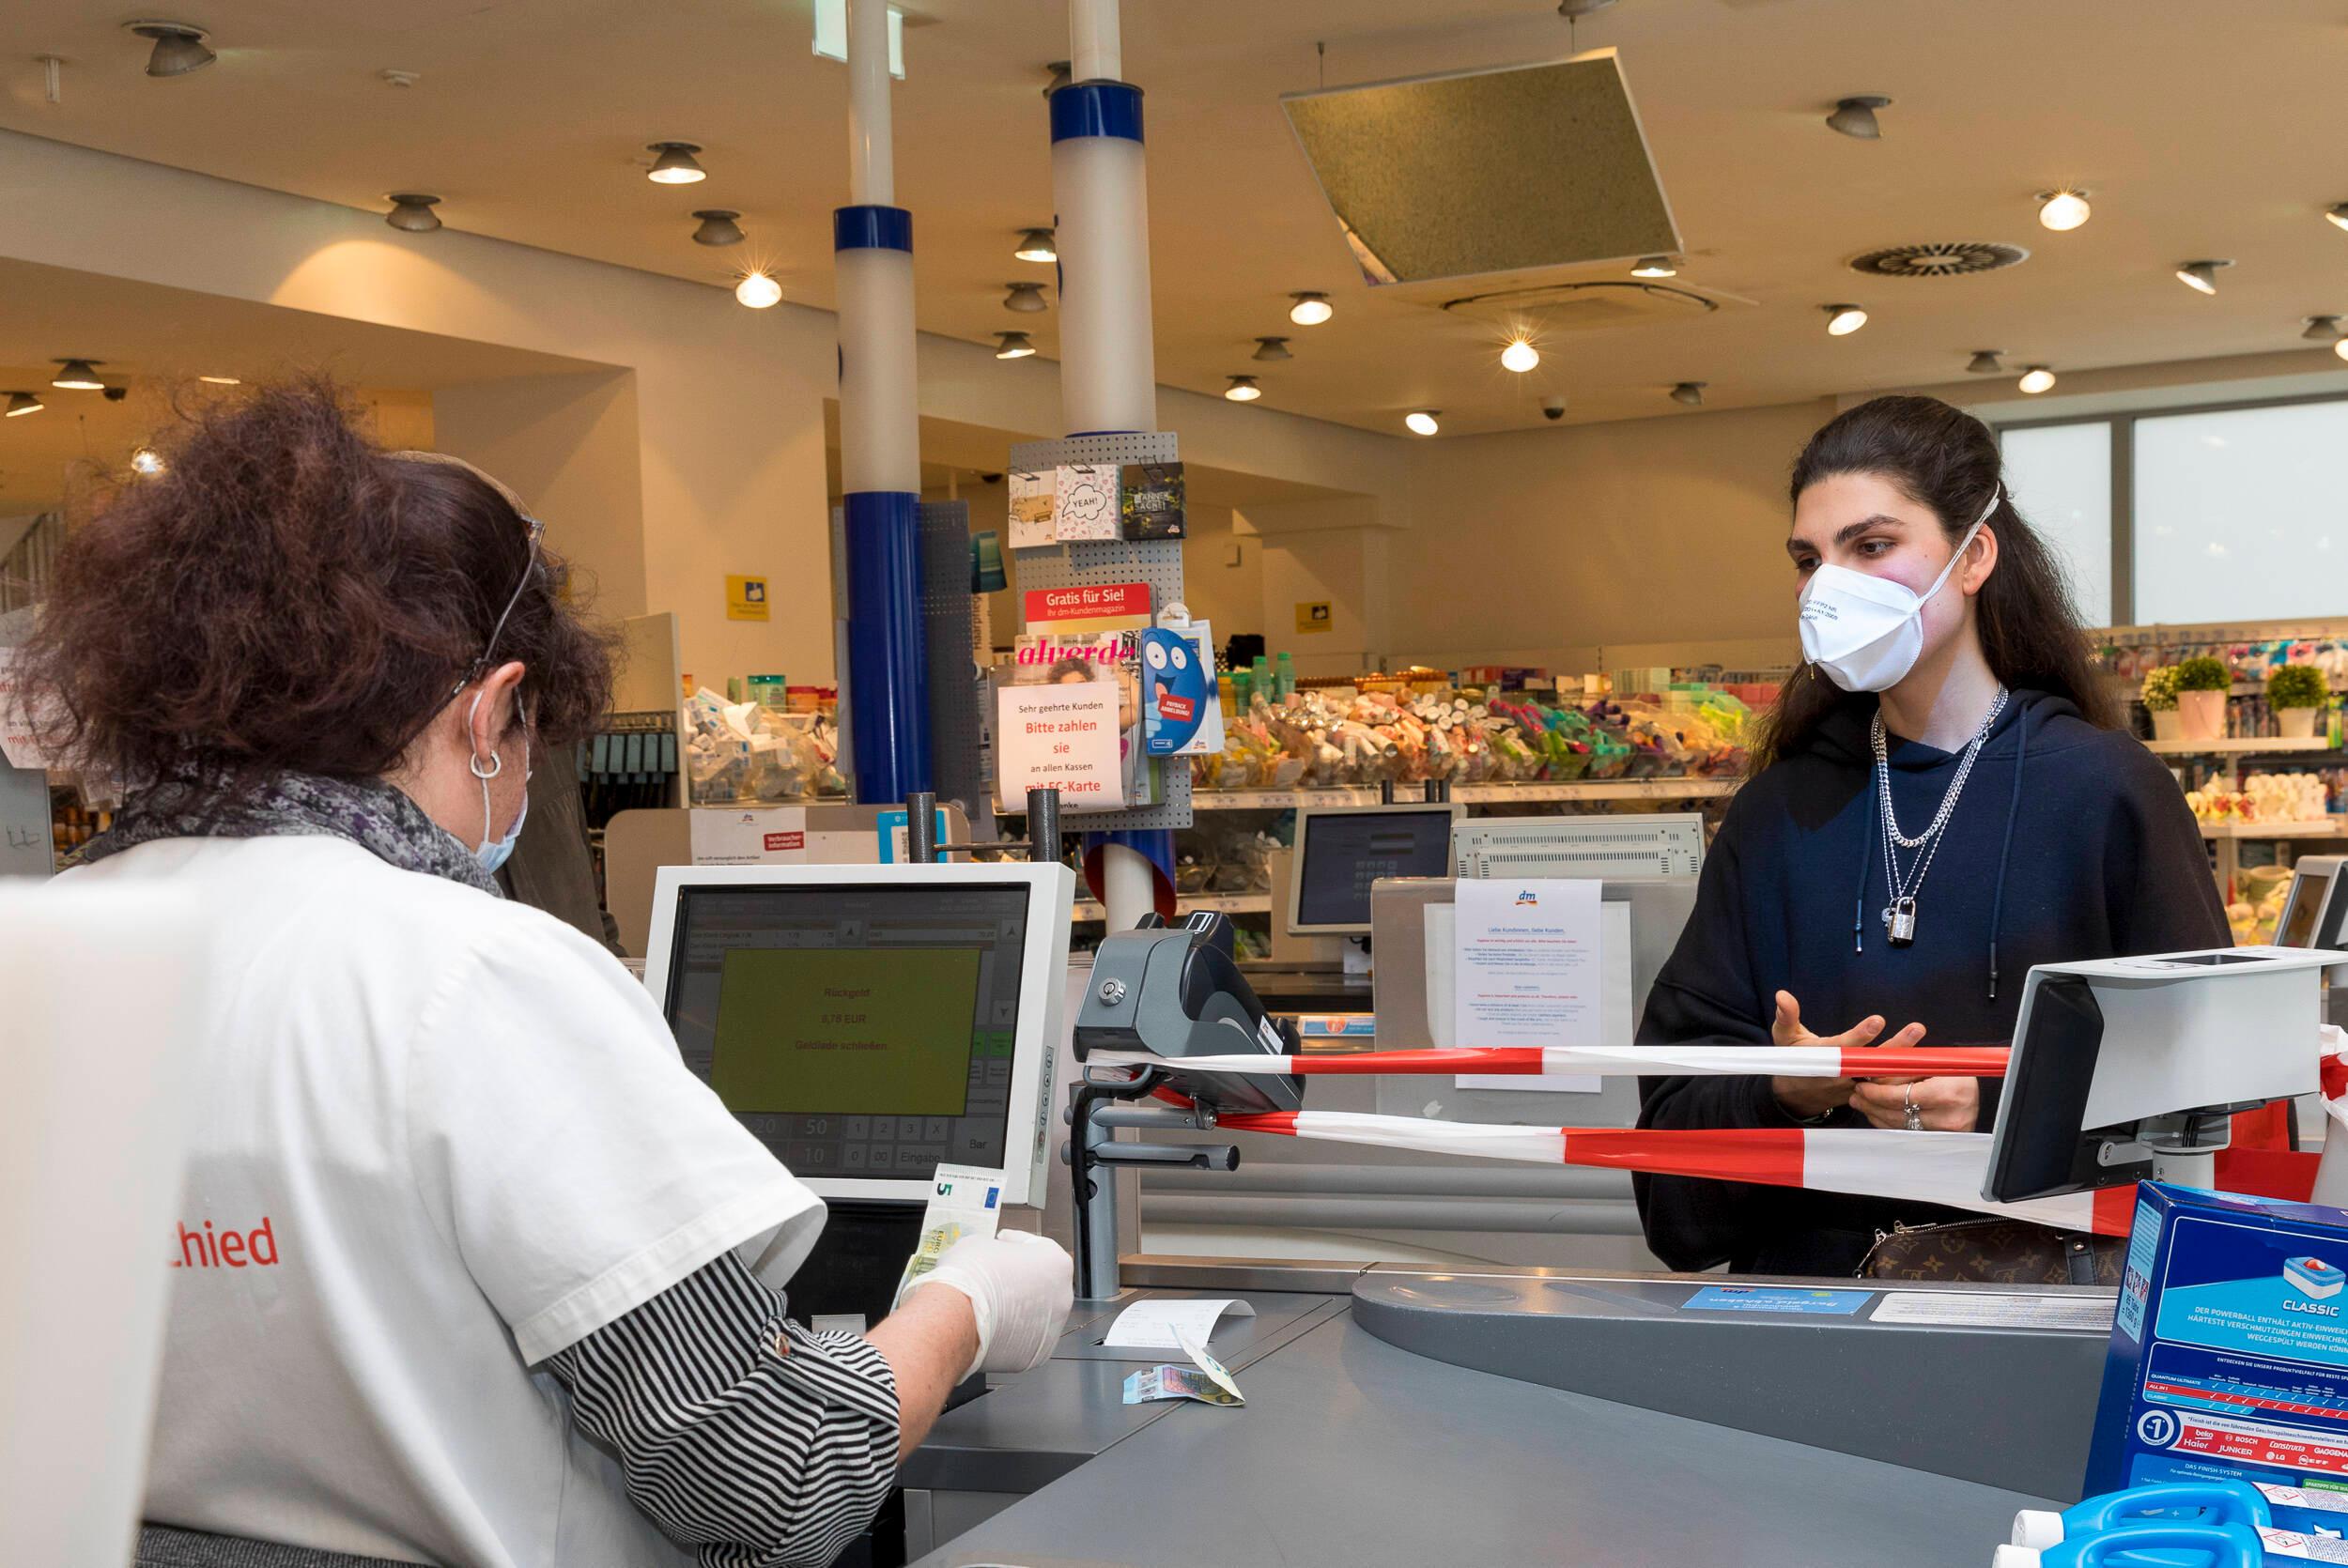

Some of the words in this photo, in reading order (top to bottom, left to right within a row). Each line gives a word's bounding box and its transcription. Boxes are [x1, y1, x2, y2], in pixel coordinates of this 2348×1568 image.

[1073, 498, 1098, 508] YEAH!
[1046, 592, 1080, 607] Gratis
[1083, 590, 1100, 604] für
[1103, 589, 1125, 602] Sie!
[1047, 608, 1057, 617] Ihr
[1058, 605, 1126, 616] dm-Kundenmagazin
[1019, 705, 1037, 714] Sehr
[1039, 704, 1071, 715] geehrte
[1072, 701, 1104, 711] Kunden
[1026, 722, 1055, 734] Bitte
[1058, 720, 1097, 732] zahlen
[1053, 742, 1071, 754] sie
[1064, 763, 1093, 772] Kassen
[1519, 890, 1536, 900] dm
[825, 988, 871, 999] Rückgeld
[844, 1014, 866, 1023] EUR
[805, 1119, 827, 1135] 50
[805, 1147, 824, 1163] 10
[969, 1139, 988, 1149] Bar
[167, 1217, 279, 1267] hied
[2282, 1299, 2340, 1316] CLASSIC
[2195, 1306, 2210, 1314] DER
[2211, 1308, 2256, 1323] POWERBALL
[2257, 1315, 2291, 1327] ENTHÄLT
[2187, 1314, 2226, 1327] HÄRTESTE
[2227, 1320, 2301, 1338] VERSCHMUTZUNGEN
[2247, 1332, 2294, 1345] WEGGESPÜLT
[2295, 1340, 2327, 1351] WERDEN
[2217, 1357, 2245, 1366] ENTDECKEN
[2151, 1374, 2176, 1382] QUANTUM
[2176, 1377, 2201, 1386] ULTIMATE
[2184, 1438, 2209, 1449] Haier
[2217, 1445, 2253, 1456] JUNKER
[2195, 1429, 2214, 1437] beko
[2235, 1436, 2259, 1445] BOSCH
[2269, 1441, 2306, 1453] Constructa
